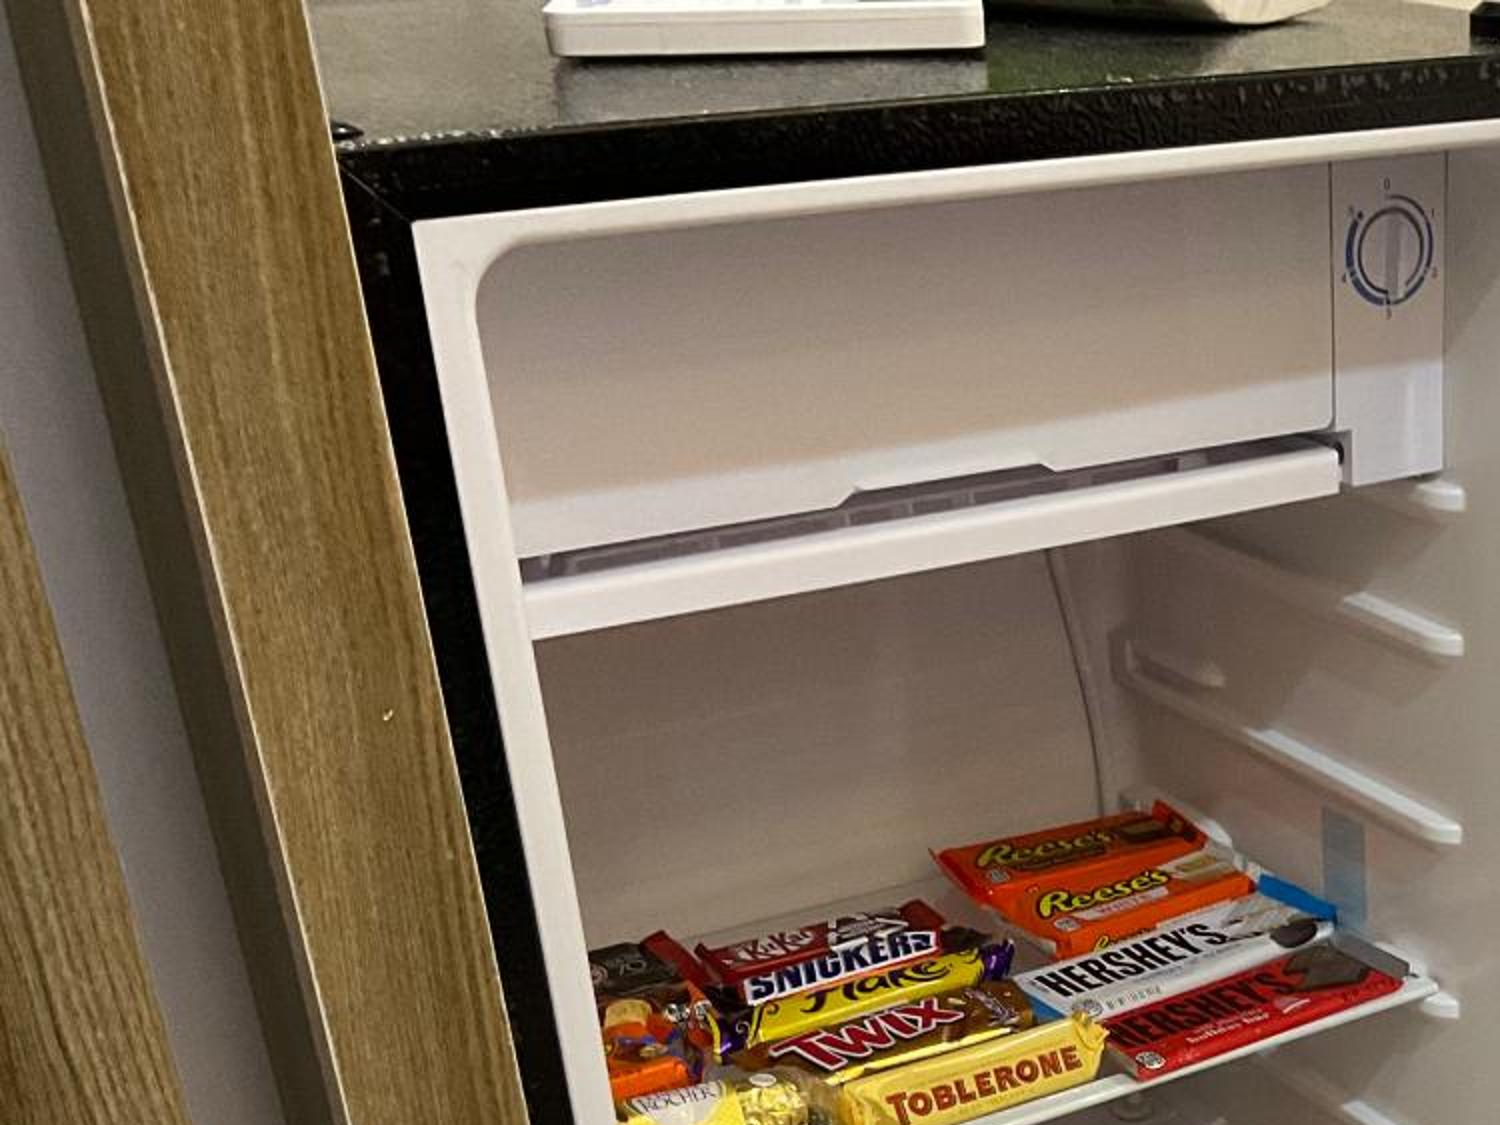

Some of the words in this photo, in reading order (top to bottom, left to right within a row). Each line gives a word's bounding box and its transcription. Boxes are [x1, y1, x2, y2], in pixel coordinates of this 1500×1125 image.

[977, 830, 1113, 867] Reese's
[1038, 870, 1170, 918] Reese's
[750, 931, 934, 1001] SNICKERS
[1034, 923, 1227, 998] HERSHEY'S
[769, 998, 964, 1071] TWIX
[1106, 973, 1293, 1047] HERSHEY'S
[639, 1084, 716, 1112] ROCHER
